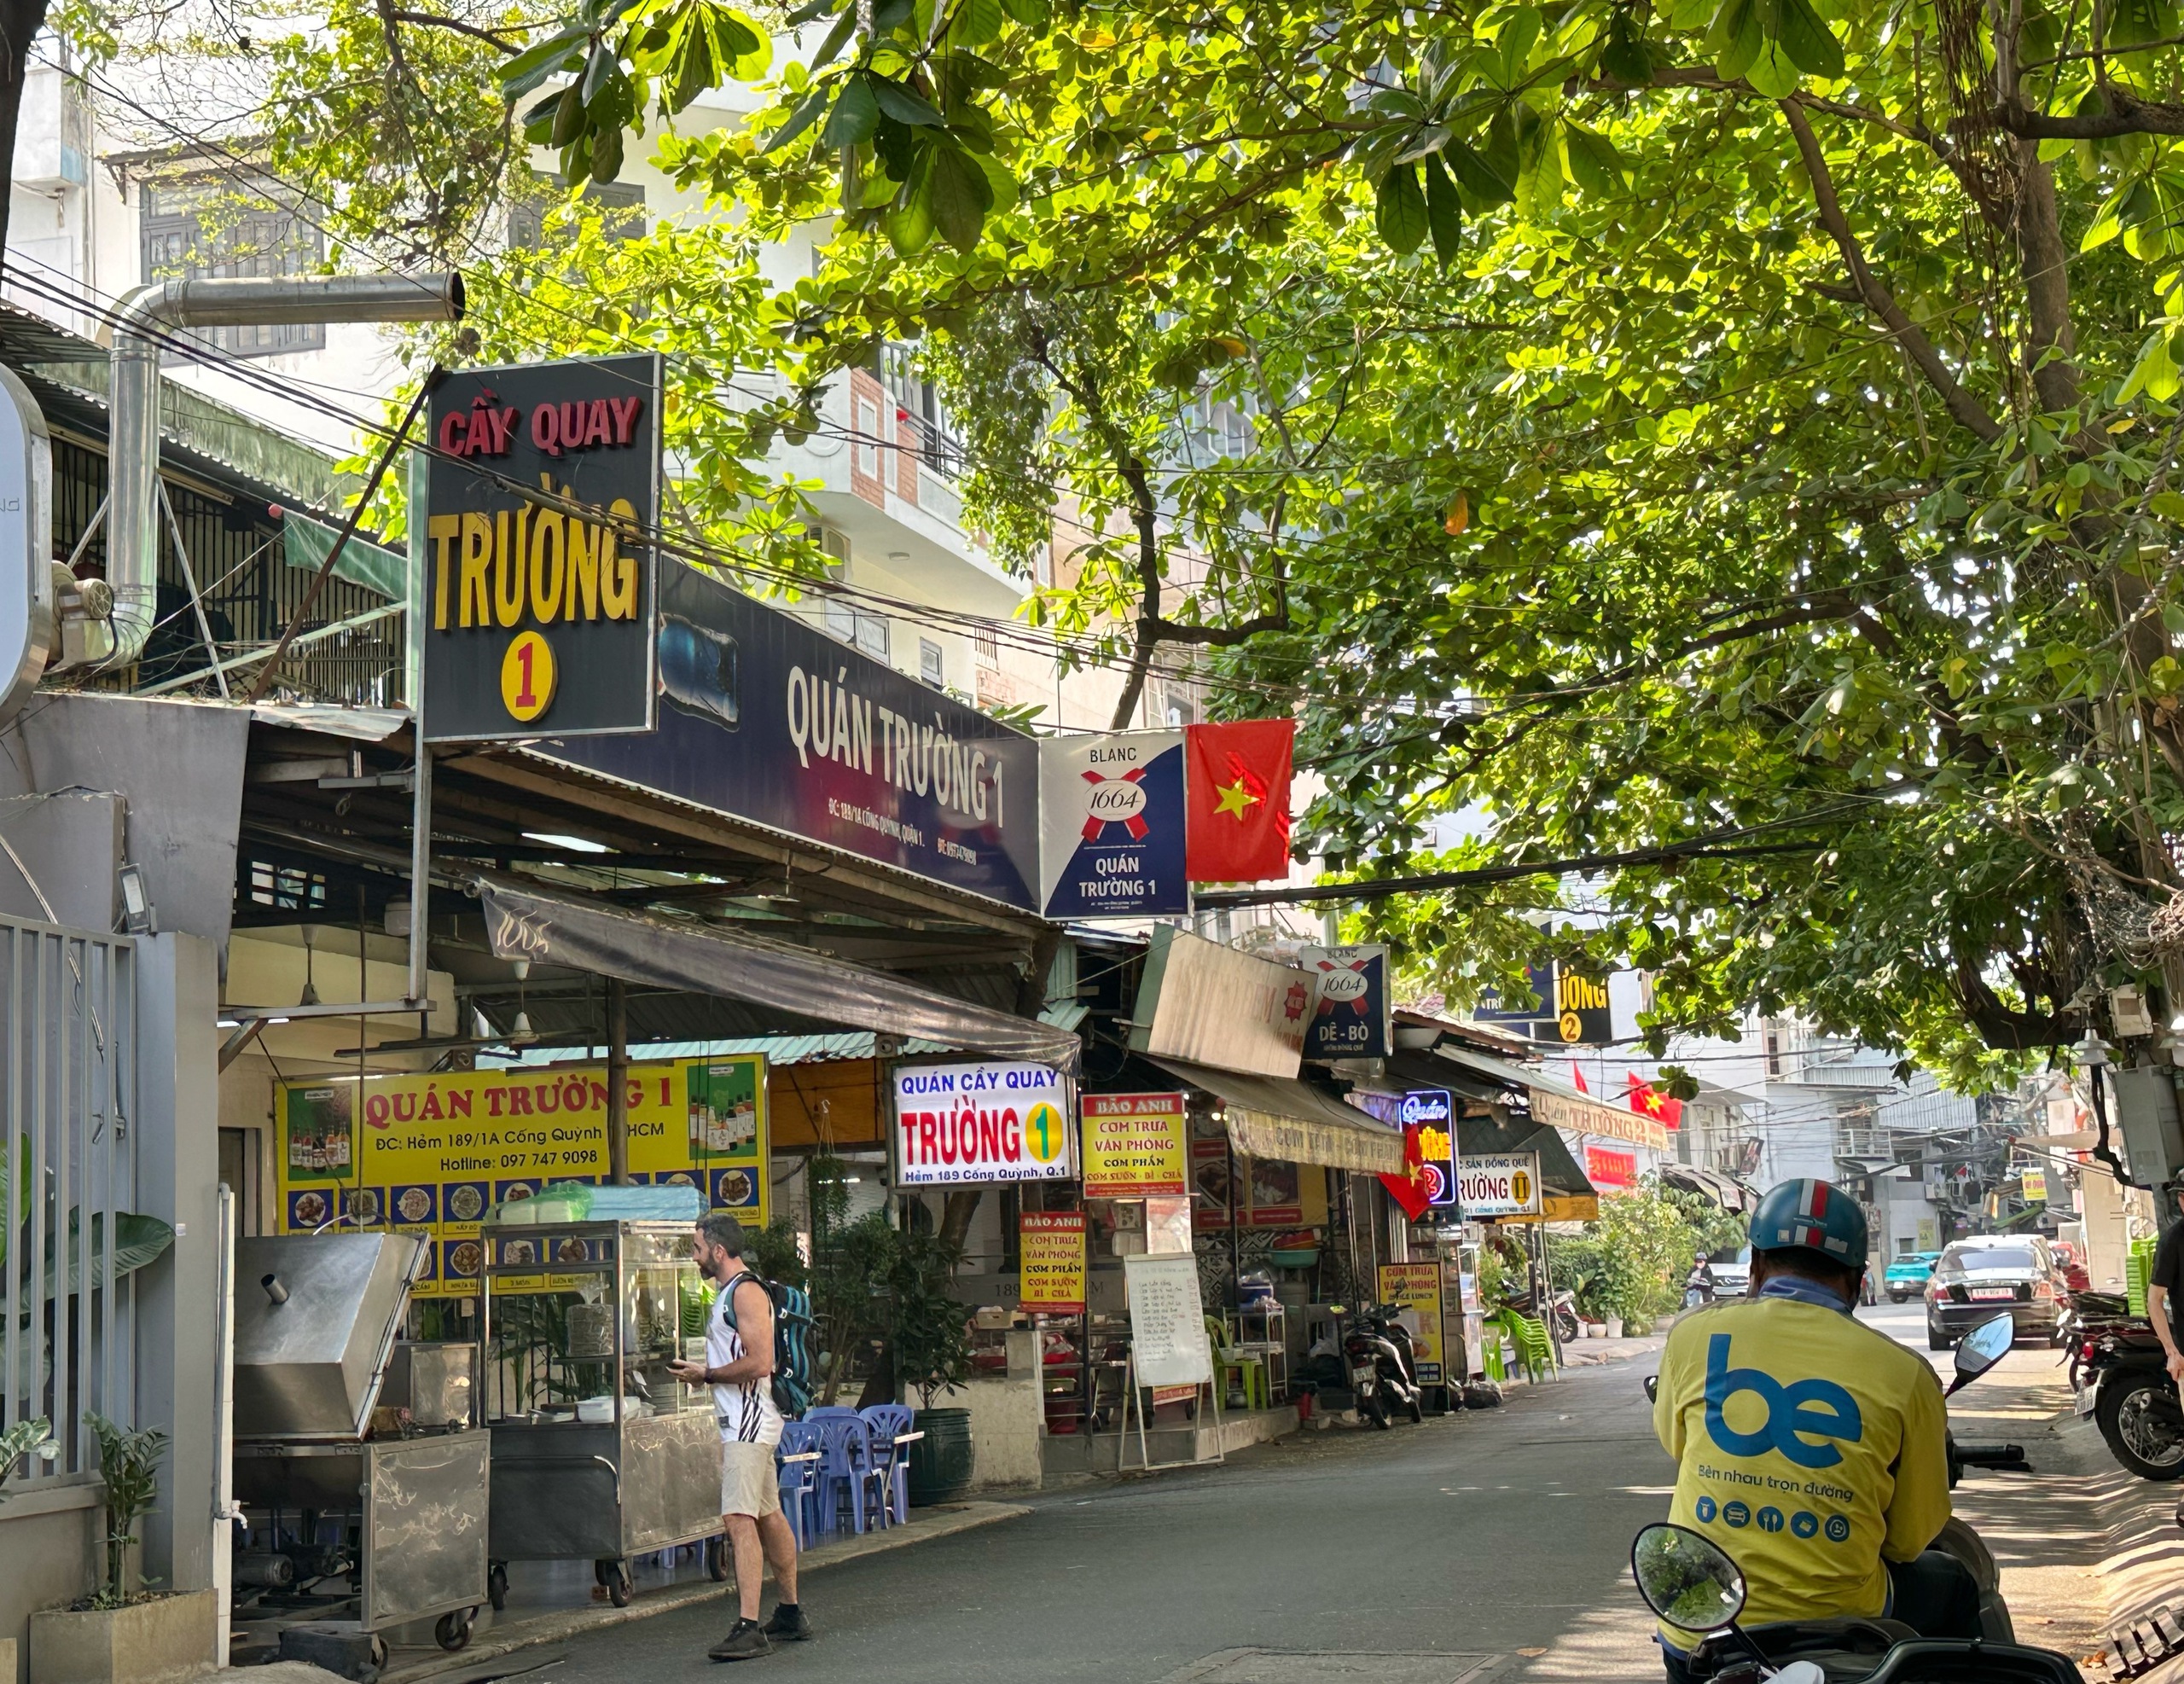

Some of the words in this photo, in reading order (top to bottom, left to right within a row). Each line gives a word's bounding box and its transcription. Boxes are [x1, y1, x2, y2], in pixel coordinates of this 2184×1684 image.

[439, 387, 520, 456] CẦY
[531, 396, 642, 456] QUAY
[428, 472, 640, 630] TRƯỜNG
[515, 642, 537, 708] 1
[787, 665, 873, 775] QUÁN
[879, 706, 987, 822] TRƯỜNG
[992, 761, 1003, 828] 1
[1089, 747, 1137, 763] BLANC
[1089, 787, 1141, 810] 1664
[1095, 853, 1140, 877] QUÁN
[1078, 876, 1145, 897] TRƯỜNG
[1147, 880, 1156, 895] 1
[1324, 976, 1364, 991] 1664
[1319, 1021, 1337, 1042] DÊ
[1349, 1020, 1368, 1041] BÒ
[1565, 1018, 1577, 1039] 2
[902, 1071, 955, 1095] QUÁN
[1006, 1070, 1058, 1089] QUAY
[365, 1083, 474, 1130] QUÁN
[484, 1073, 645, 1117] TRƯỜNG
[658, 1077, 673, 1107] 1
[1135, 1100, 1173, 1113] ANH
[901, 1095, 1021, 1165] TRƯỜNG
[1036, 1107, 1049, 1159] 1
[1100, 1121, 1130, 1133] CƠM
[1134, 1120, 1168, 1132] TRƯA
[375, 1135, 403, 1152] ĐC:
[407, 1131, 443, 1149] Hẻm
[448, 1132, 500, 1148] 189/1A
[504, 1125, 547, 1147] Cống
[551, 1125, 602, 1142] Quỳnh
[1126, 1138, 1174, 1151] PHÒNG
[440, 1156, 497, 1172] Hotline:
[500, 1153, 526, 1168] 097
[531, 1152, 558, 1166] 747
[562, 1149, 598, 1164] 9098
[938, 1170, 960, 1181] 189
[963, 1167, 995, 1182] Cống
[1046, 1165, 1066, 1176] Q.1
[1460, 1172, 1508, 1201] RƯỜNG
[1054, 1217, 1082, 1227] ANH
[1705, 1333, 1862, 1468] be
[1723, 1470, 1763, 1486] nhau
[1767, 1475, 1799, 1494] trọn
[1804, 1482, 1854, 1502] đường
